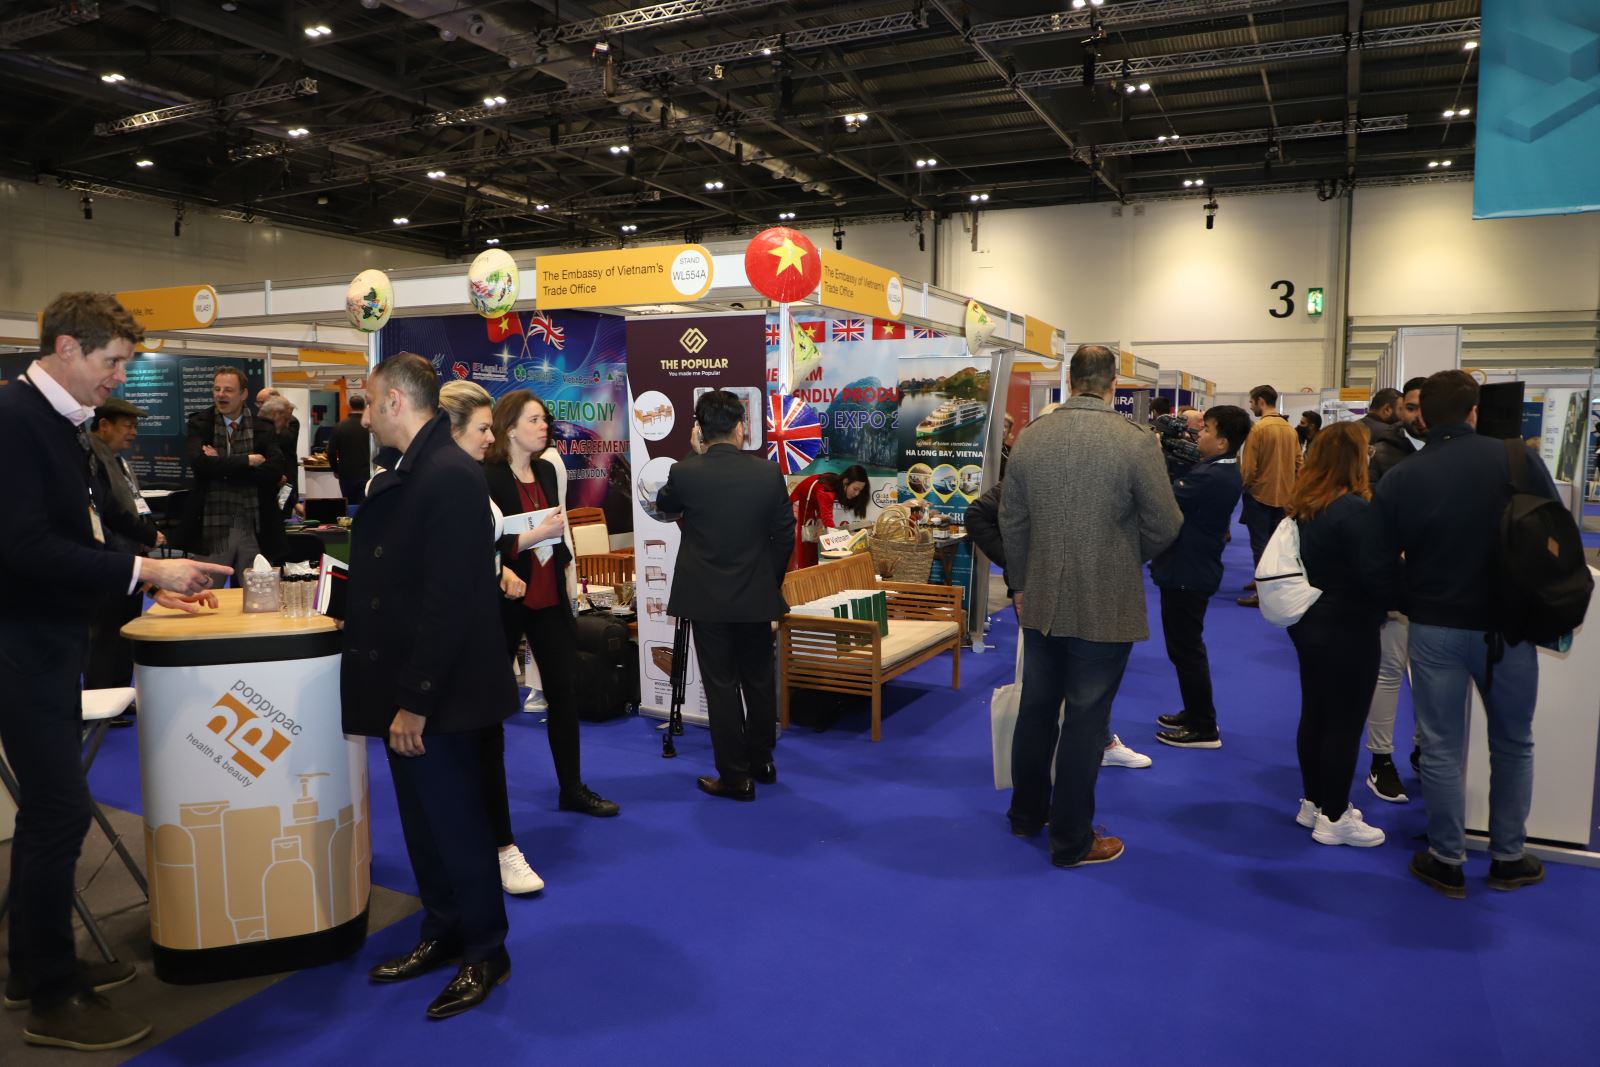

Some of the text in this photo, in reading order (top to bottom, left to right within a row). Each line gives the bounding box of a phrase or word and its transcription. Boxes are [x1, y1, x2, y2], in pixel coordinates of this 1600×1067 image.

[679, 256, 700, 265] STAND
[543, 262, 664, 281] The Embassy of Vietnam's
[672, 269, 707, 281] WL554A
[824, 265, 834, 278] The
[835, 268, 857, 286] Embassy
[543, 283, 597, 296] Trade Office
[824, 281, 854, 298] Trade Office
[1268, 279, 1295, 319] 3
[660, 358, 729, 370] THE POPULAR
[544, 400, 616, 422] REMONY
[834, 410, 887, 429] EXPO
[570, 440, 630, 455] AGREEMENT
[917, 449, 938, 457] LONG
[938, 450, 955, 458] BAY,
[956, 450, 984, 458] VIETNA
[230, 679, 303, 736] poppypac
[186, 732, 253, 788] health & beauty
